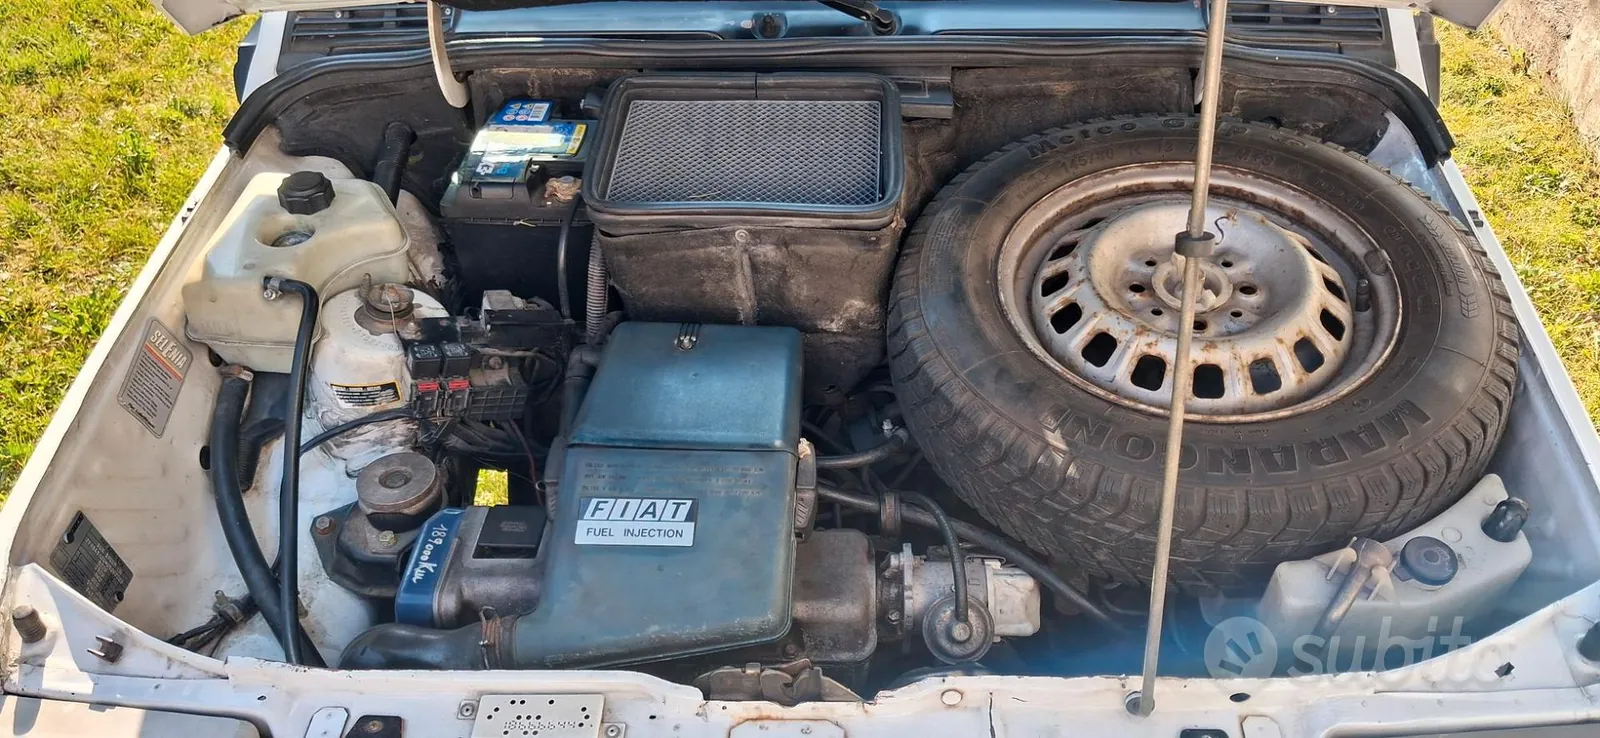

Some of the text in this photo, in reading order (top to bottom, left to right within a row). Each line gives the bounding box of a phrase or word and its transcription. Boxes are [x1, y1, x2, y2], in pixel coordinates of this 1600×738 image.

[150, 329, 188, 370] SELENIA
[589, 500, 687, 520] FIAT
[586, 527, 684, 538] FUEL INJECTION
